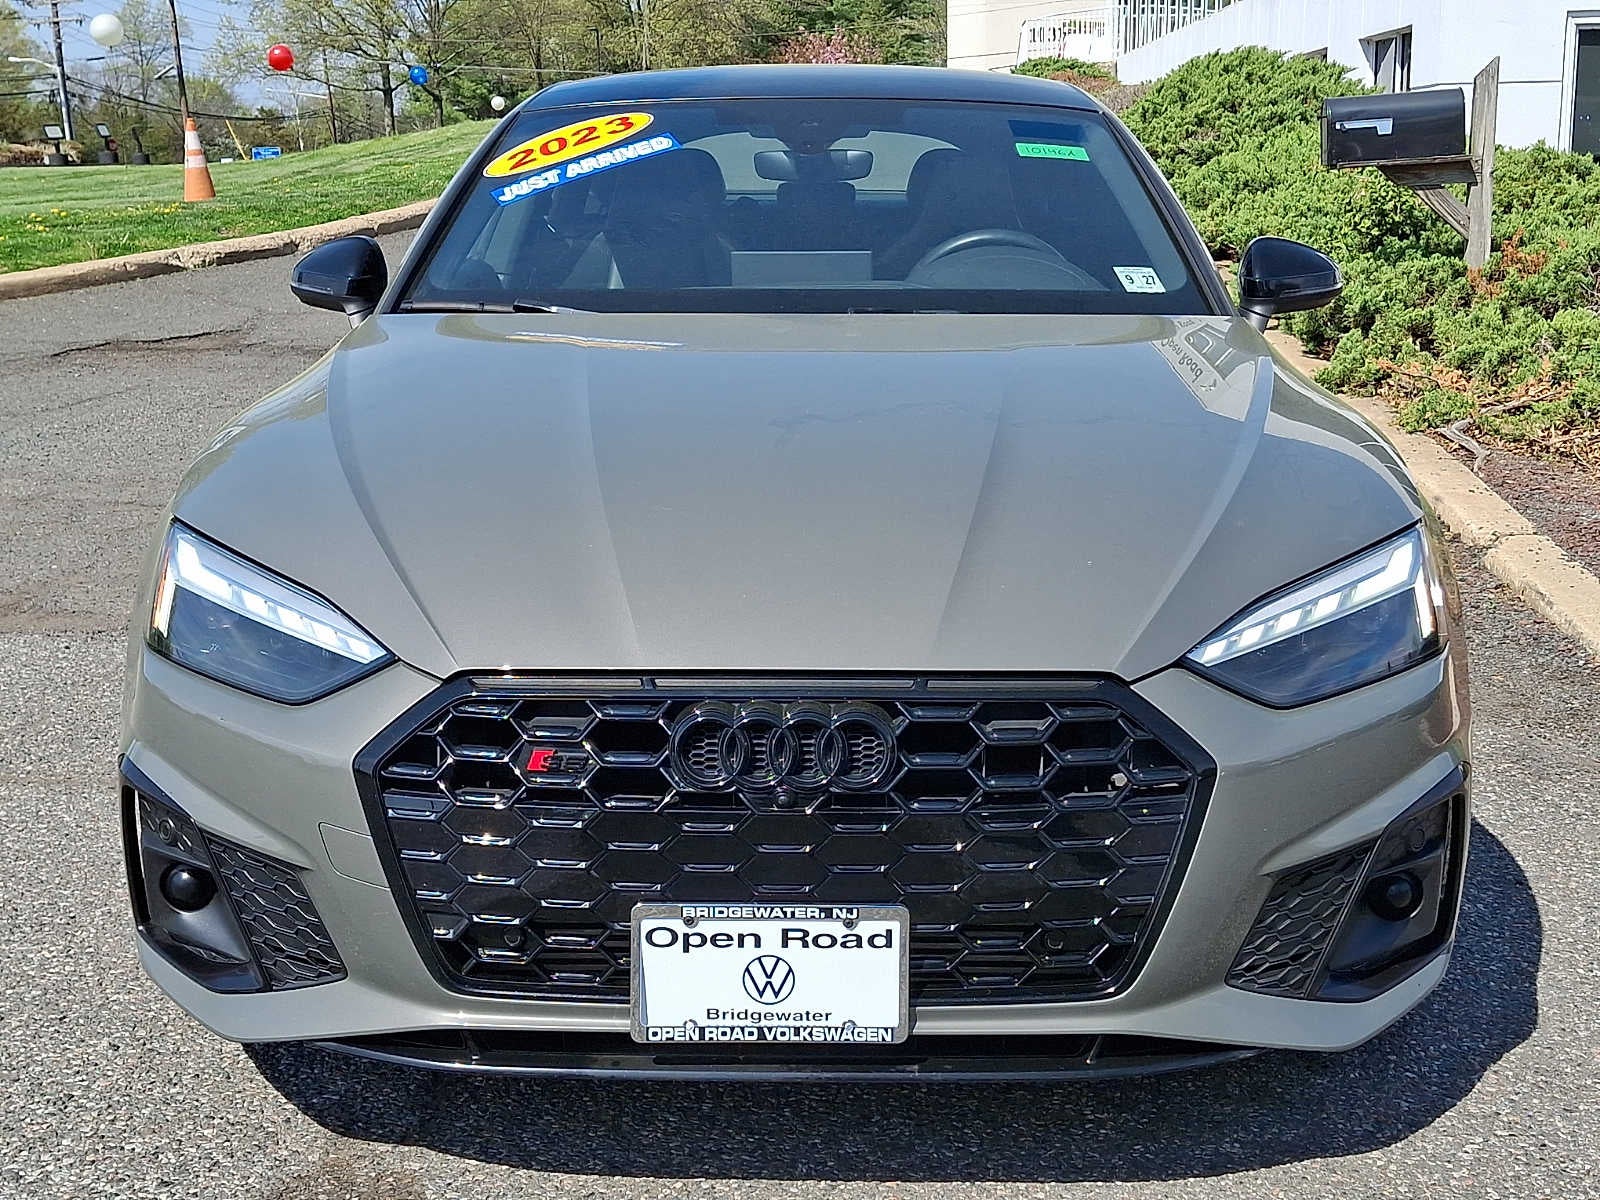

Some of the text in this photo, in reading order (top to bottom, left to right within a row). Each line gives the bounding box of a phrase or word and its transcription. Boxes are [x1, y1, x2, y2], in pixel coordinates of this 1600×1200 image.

[507, 116, 635, 171] 2023
[498, 136, 674, 202] JUST ARRIVED
[1124, 274, 1157, 286] 9 27
[681, 907, 859, 920] BRIDGEWATER, NJ
[645, 926, 893, 953] Open Road
[706, 1007, 832, 1023] Bridgewater
[648, 1027, 893, 1042] OPEN ROAD VOLKSWAGEN
